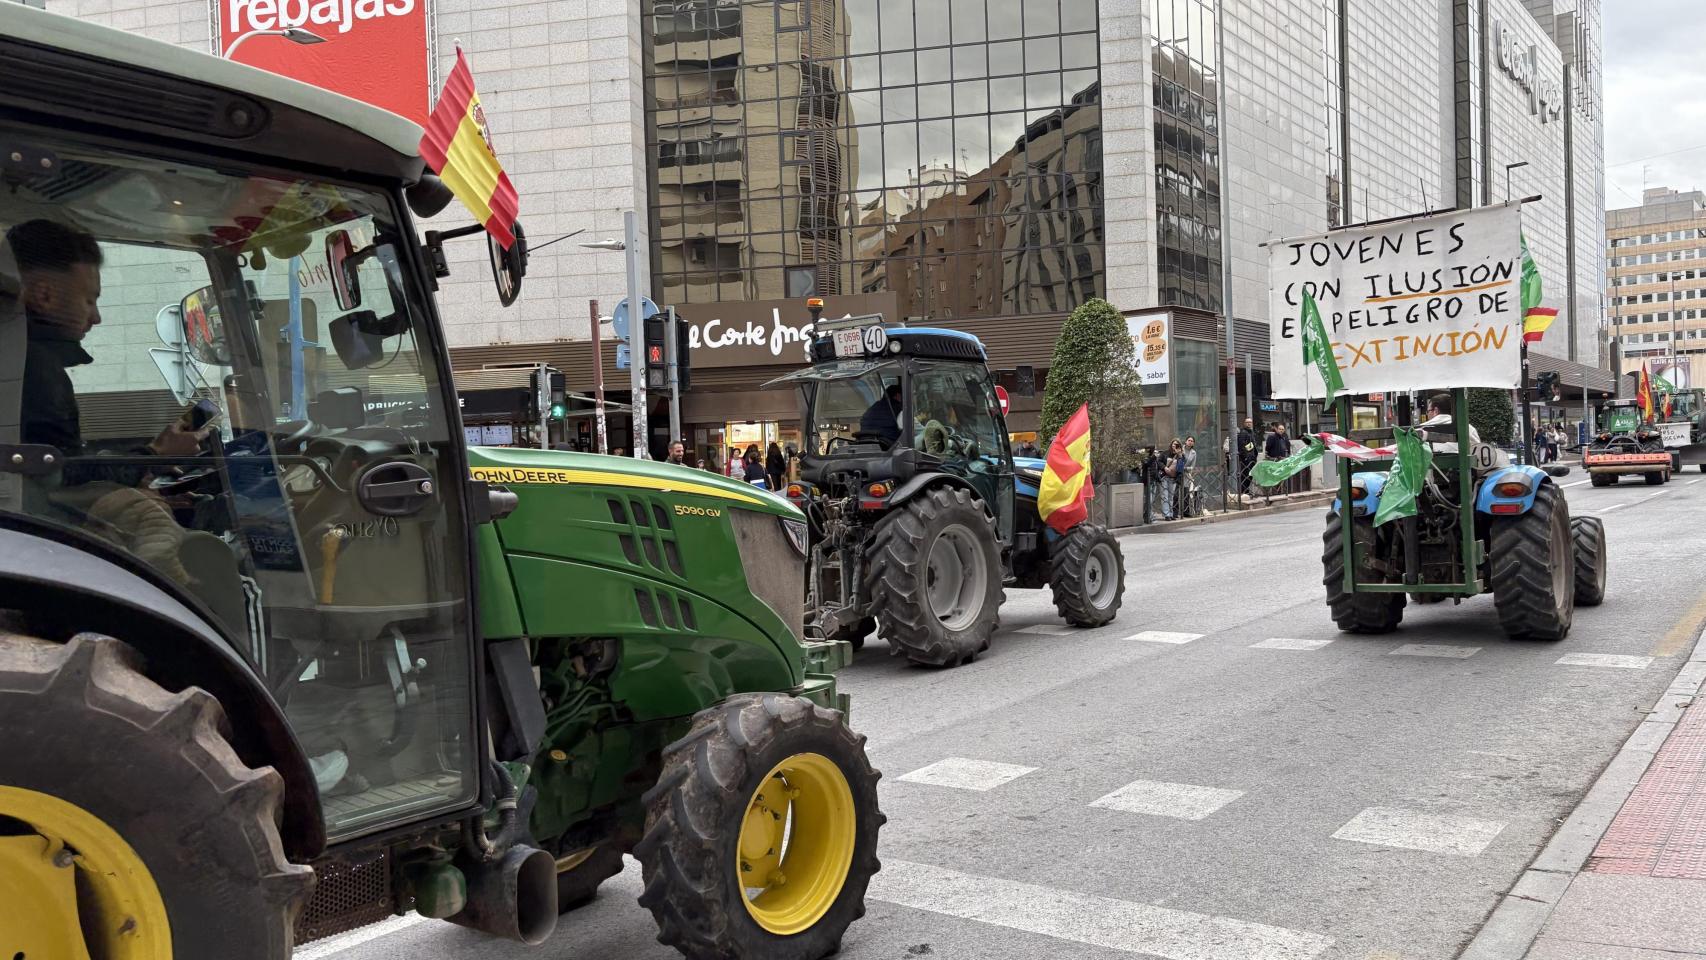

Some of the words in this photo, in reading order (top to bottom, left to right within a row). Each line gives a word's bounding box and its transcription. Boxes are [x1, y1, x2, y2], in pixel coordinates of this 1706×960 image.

[1363, 255, 1513, 299] ILUSIÓN
[1332, 296, 1463, 334] PELIGRO
[1478, 290, 1510, 315] DE
[703, 318, 767, 349] Corte
[866, 328, 883, 350] 40
[1330, 323, 1509, 371] EXTINCIÓN
[513, 469, 568, 482] DEERE
[674, 504, 705, 516] 5090
[706, 508, 721, 517] GV
